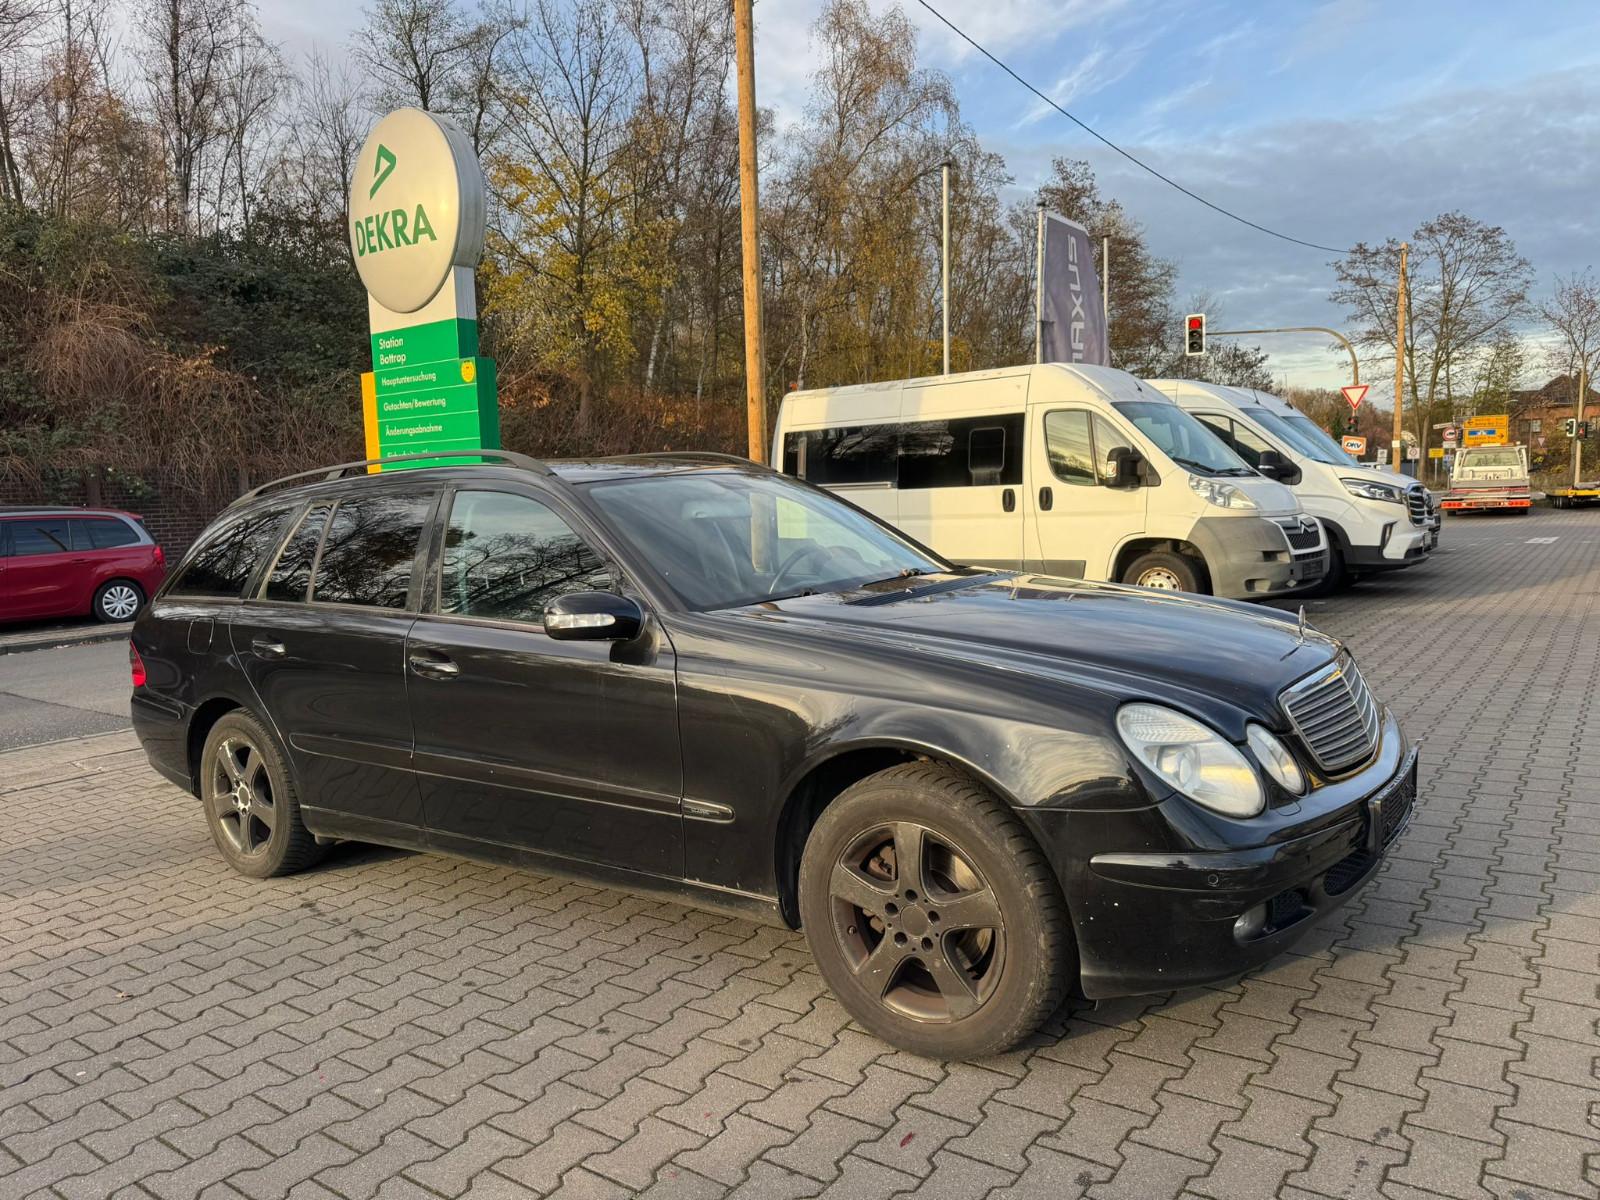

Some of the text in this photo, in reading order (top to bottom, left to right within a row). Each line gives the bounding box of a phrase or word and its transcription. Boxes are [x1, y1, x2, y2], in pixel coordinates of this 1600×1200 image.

[355, 204, 437, 257] DEKRA
[379, 336, 404, 350] Station
[380, 353, 406, 365] Bottrop
[381, 371, 437, 387] Hauptuntersuchung
[383, 398, 447, 412] Gutachten/Bewertung
[385, 424, 443, 437] Änderungsabnahme
